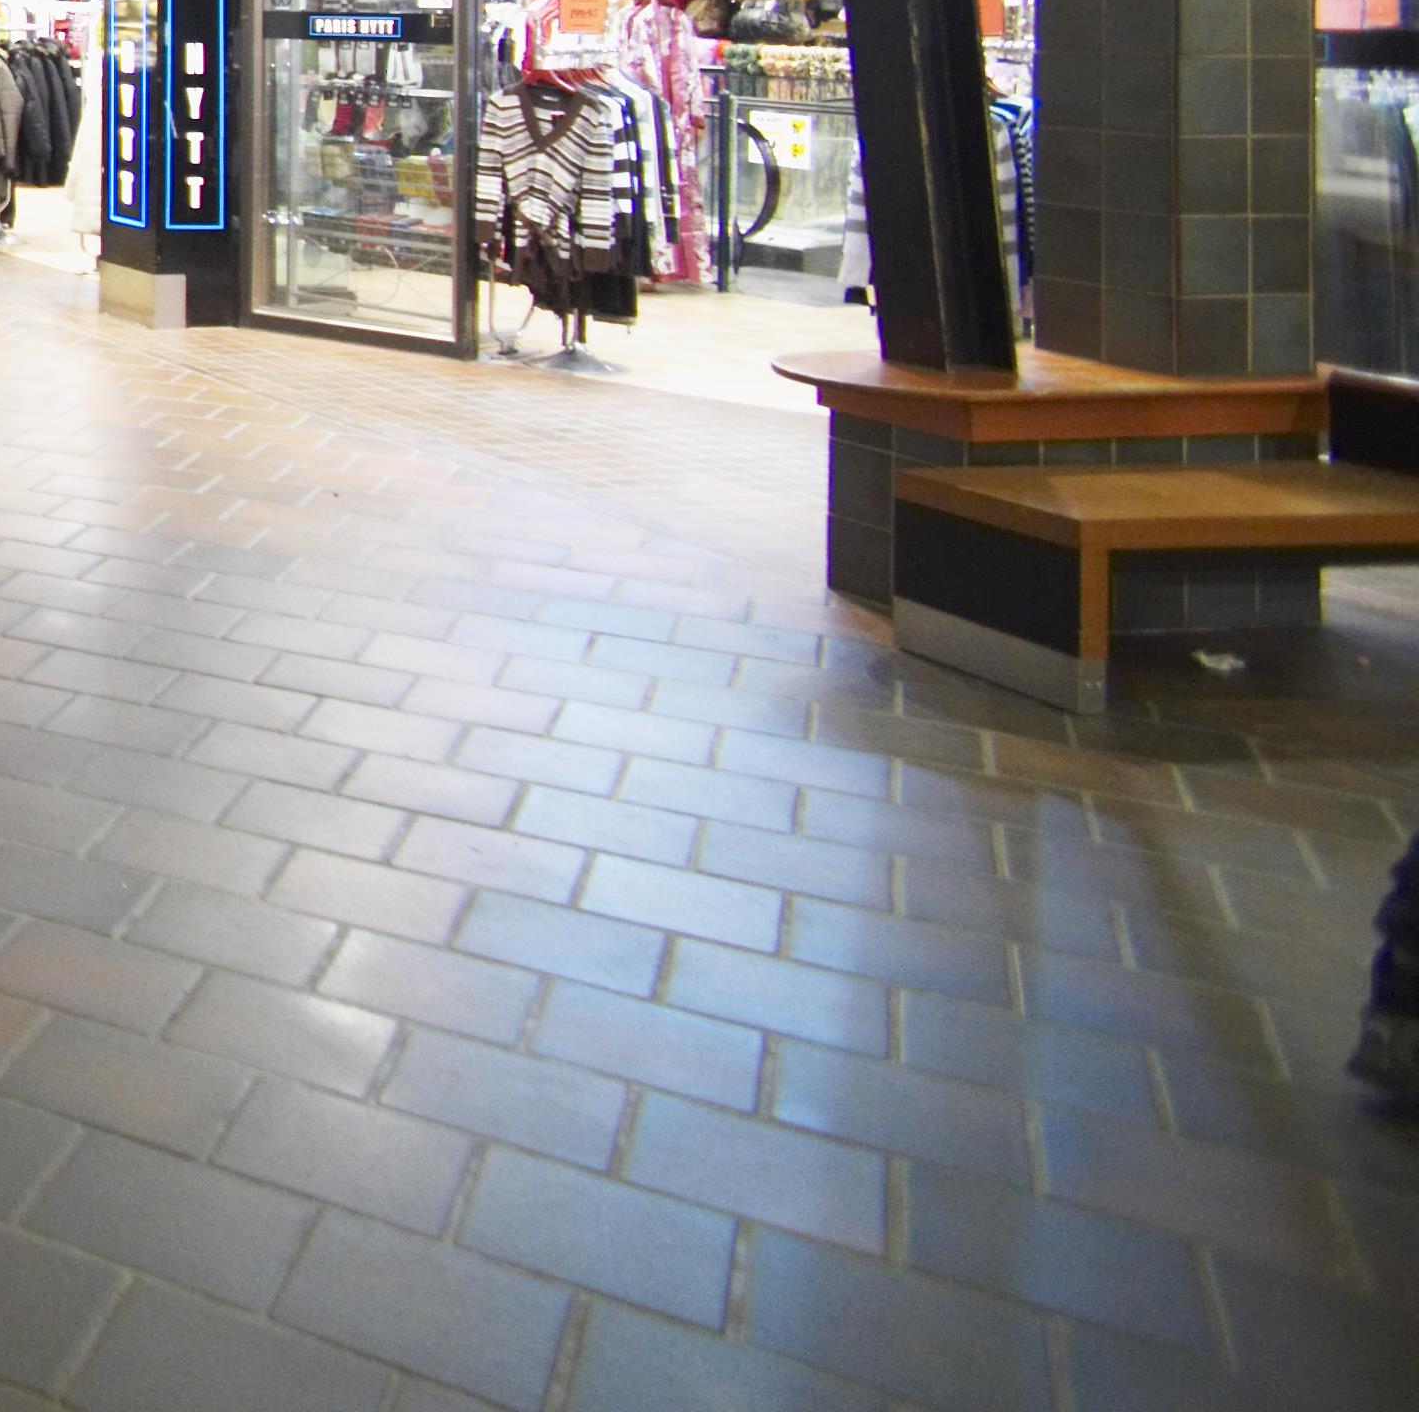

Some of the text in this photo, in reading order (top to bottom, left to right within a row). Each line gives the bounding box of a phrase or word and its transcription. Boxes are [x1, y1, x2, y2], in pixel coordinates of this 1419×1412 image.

[314, 18, 395, 35] PARIS NYTT
[120, 40, 136, 206] NYTT
[184, 41, 207, 209] NYTT
